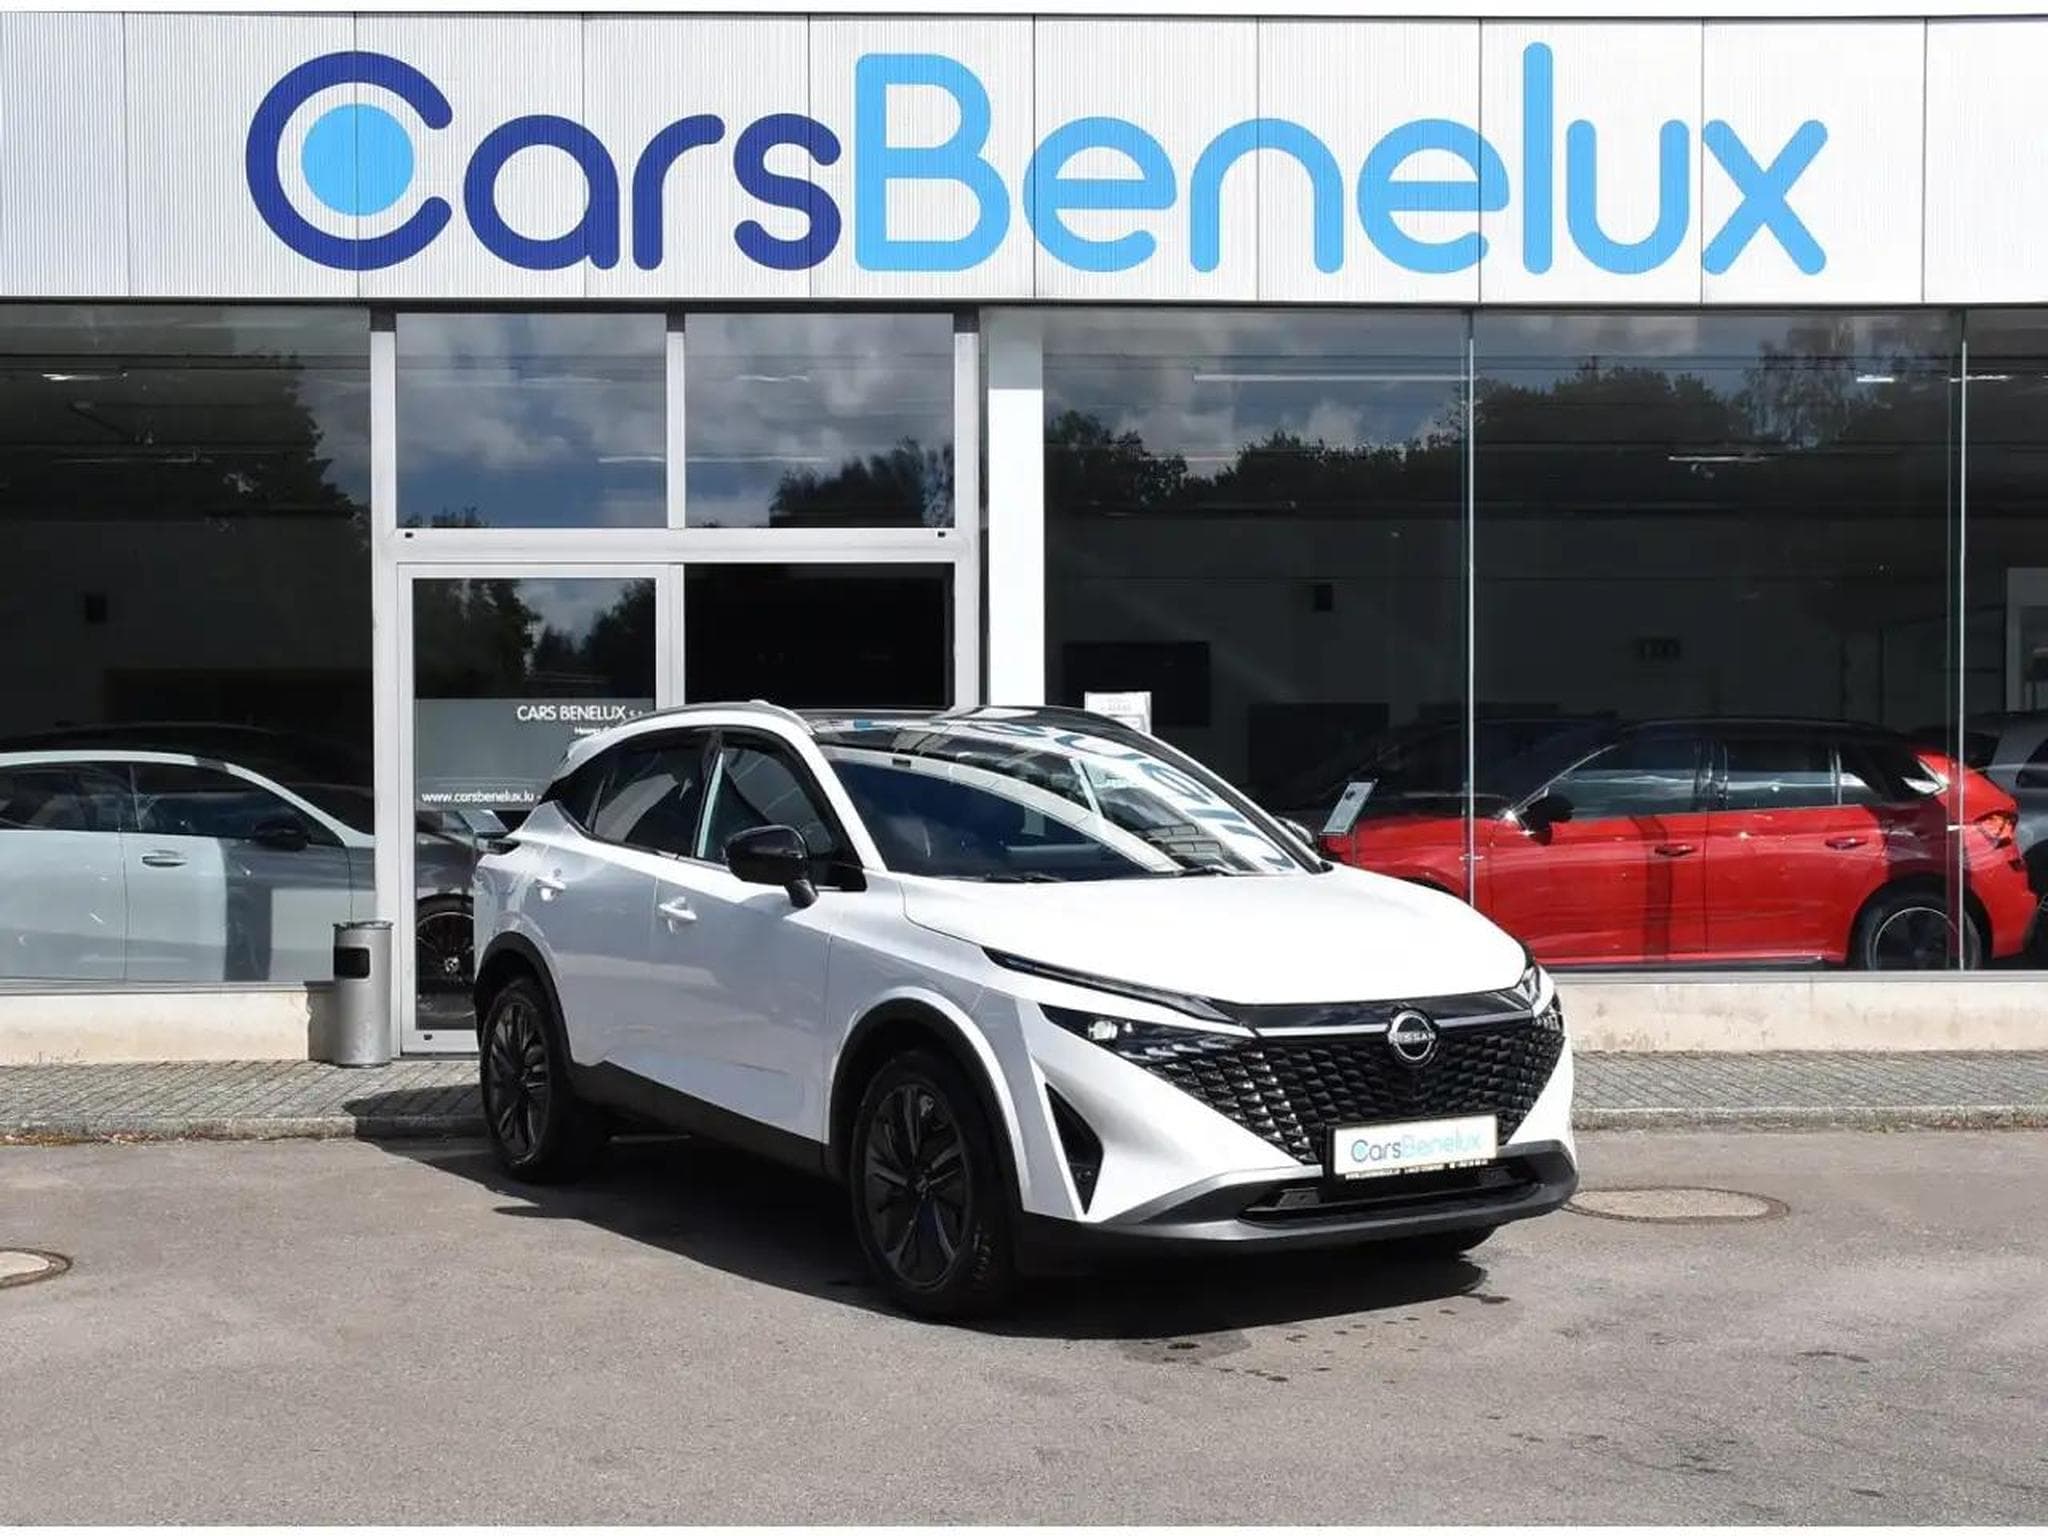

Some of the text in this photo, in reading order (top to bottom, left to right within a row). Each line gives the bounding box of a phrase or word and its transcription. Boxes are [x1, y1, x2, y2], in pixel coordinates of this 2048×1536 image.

[246, 41, 1828, 275] CarsBenelux
[516, 704, 557, 721] CARS
[559, 704, 627, 721] BENELUX
[421, 789, 535, 803] www.carsbenelux.lu
[1350, 1126, 1482, 1163] CarsBenelux
